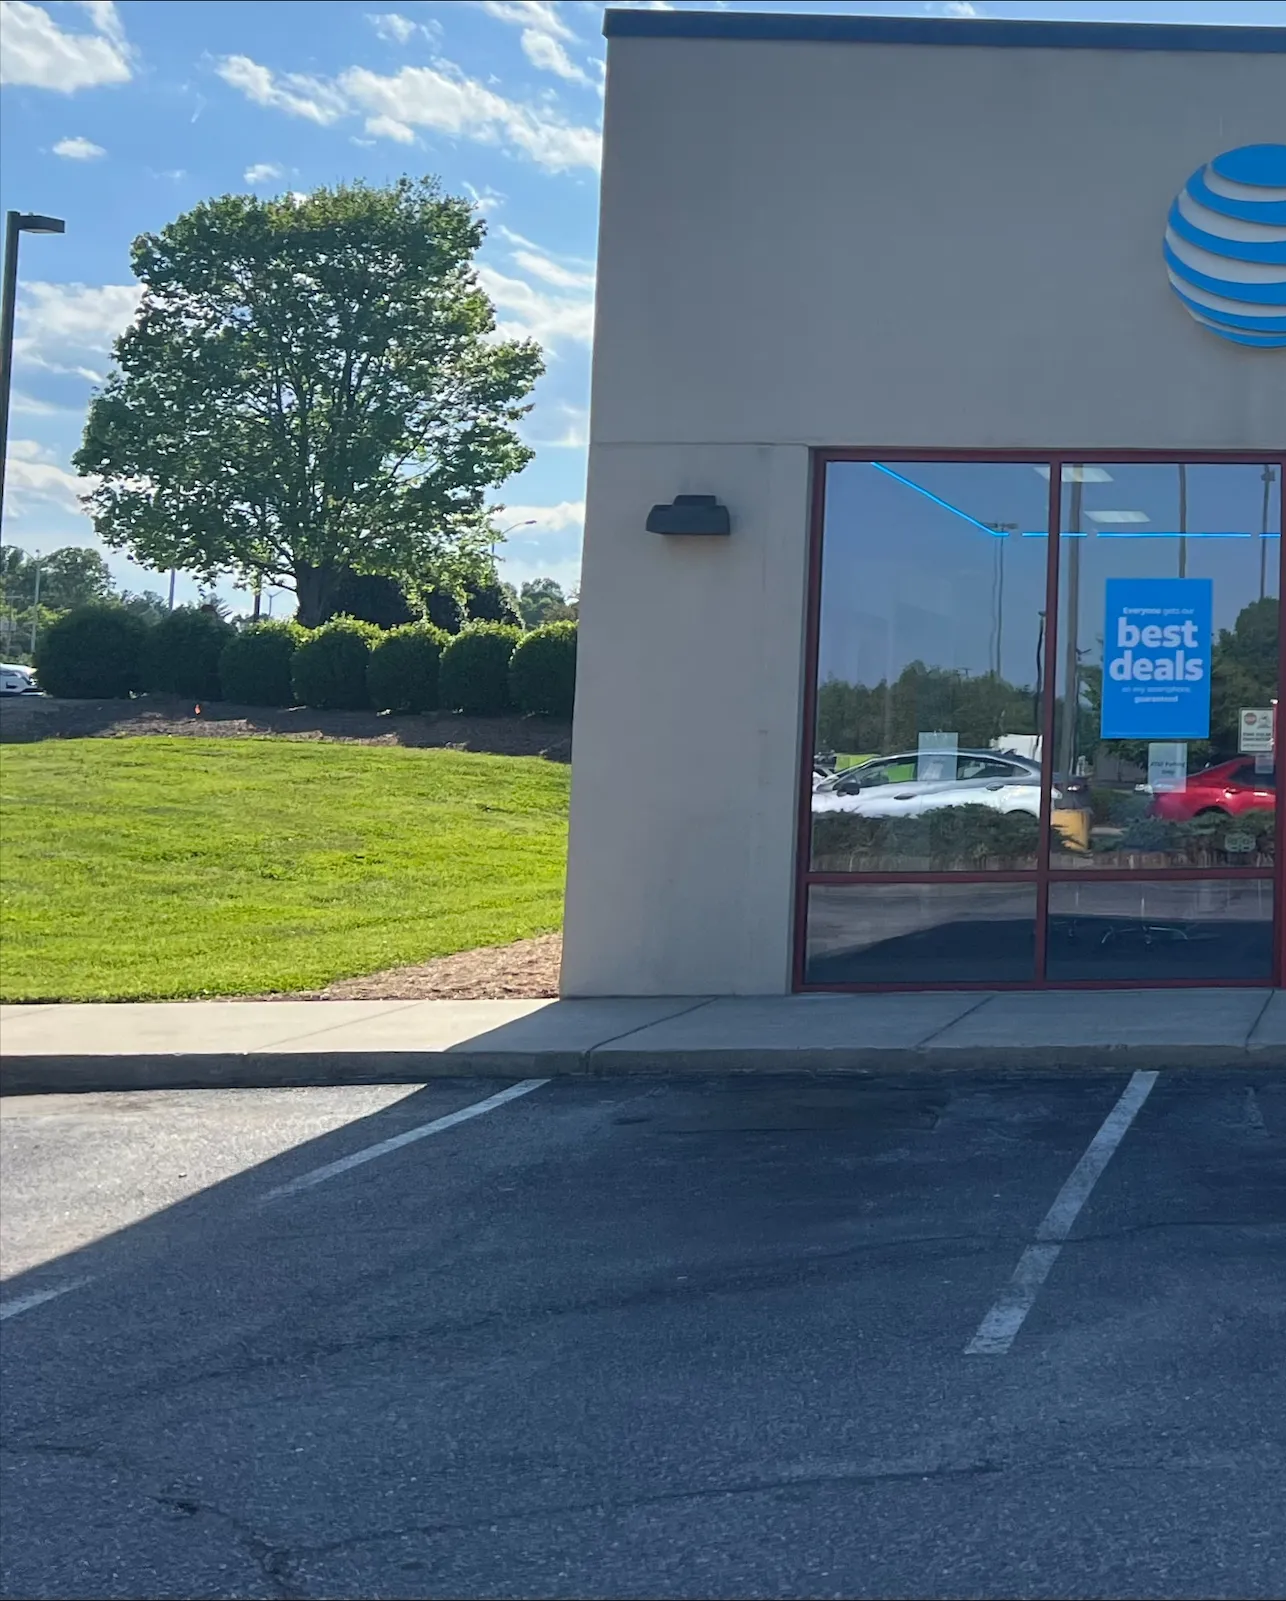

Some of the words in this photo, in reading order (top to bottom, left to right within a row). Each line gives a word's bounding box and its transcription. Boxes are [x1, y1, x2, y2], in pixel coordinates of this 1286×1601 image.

[1122, 607, 1161, 616] Everyone
[1117, 617, 1199, 648] best
[1109, 650, 1204, 682] deals
